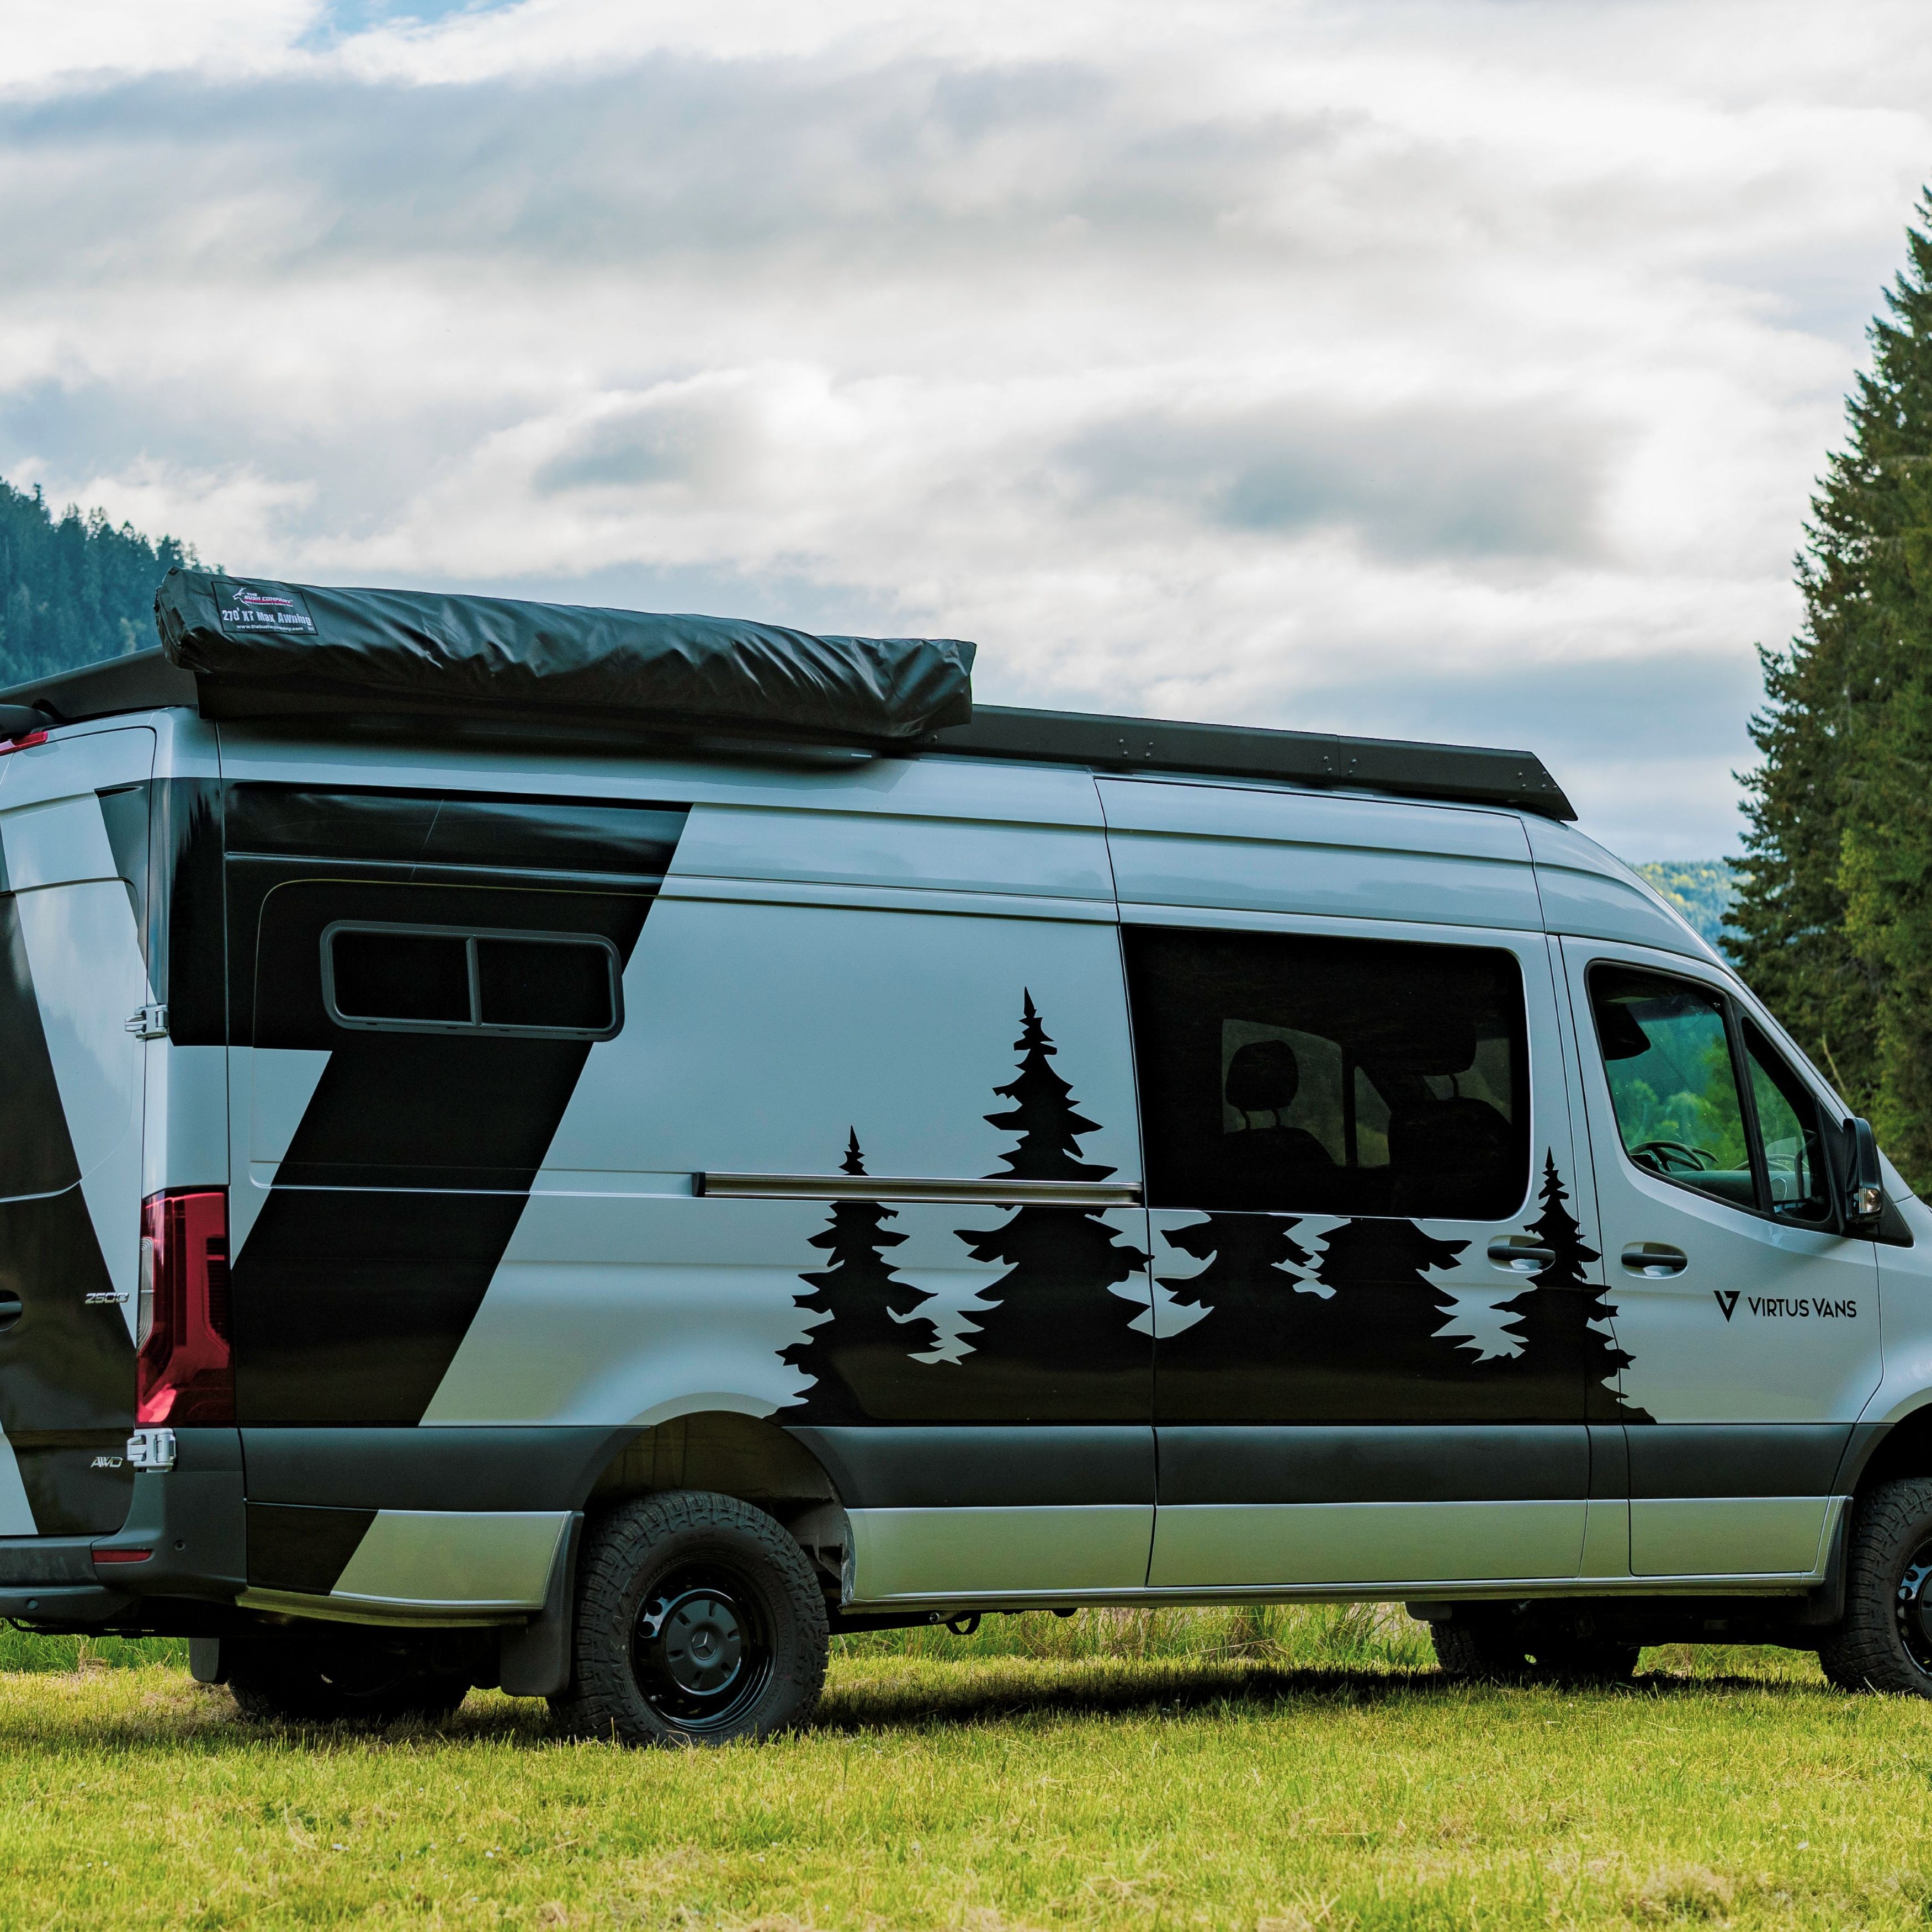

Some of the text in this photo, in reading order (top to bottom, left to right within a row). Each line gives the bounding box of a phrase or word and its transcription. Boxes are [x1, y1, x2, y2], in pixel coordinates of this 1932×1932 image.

[242, 611, 254, 622] XT
[256, 611, 275, 622] Max
[278, 612, 312, 626] Awning
[84, 1292, 130, 1304] 2500
[1748, 1297, 1857, 1318] VIRTUS VANS
[91, 1456, 123, 1468] AWD
